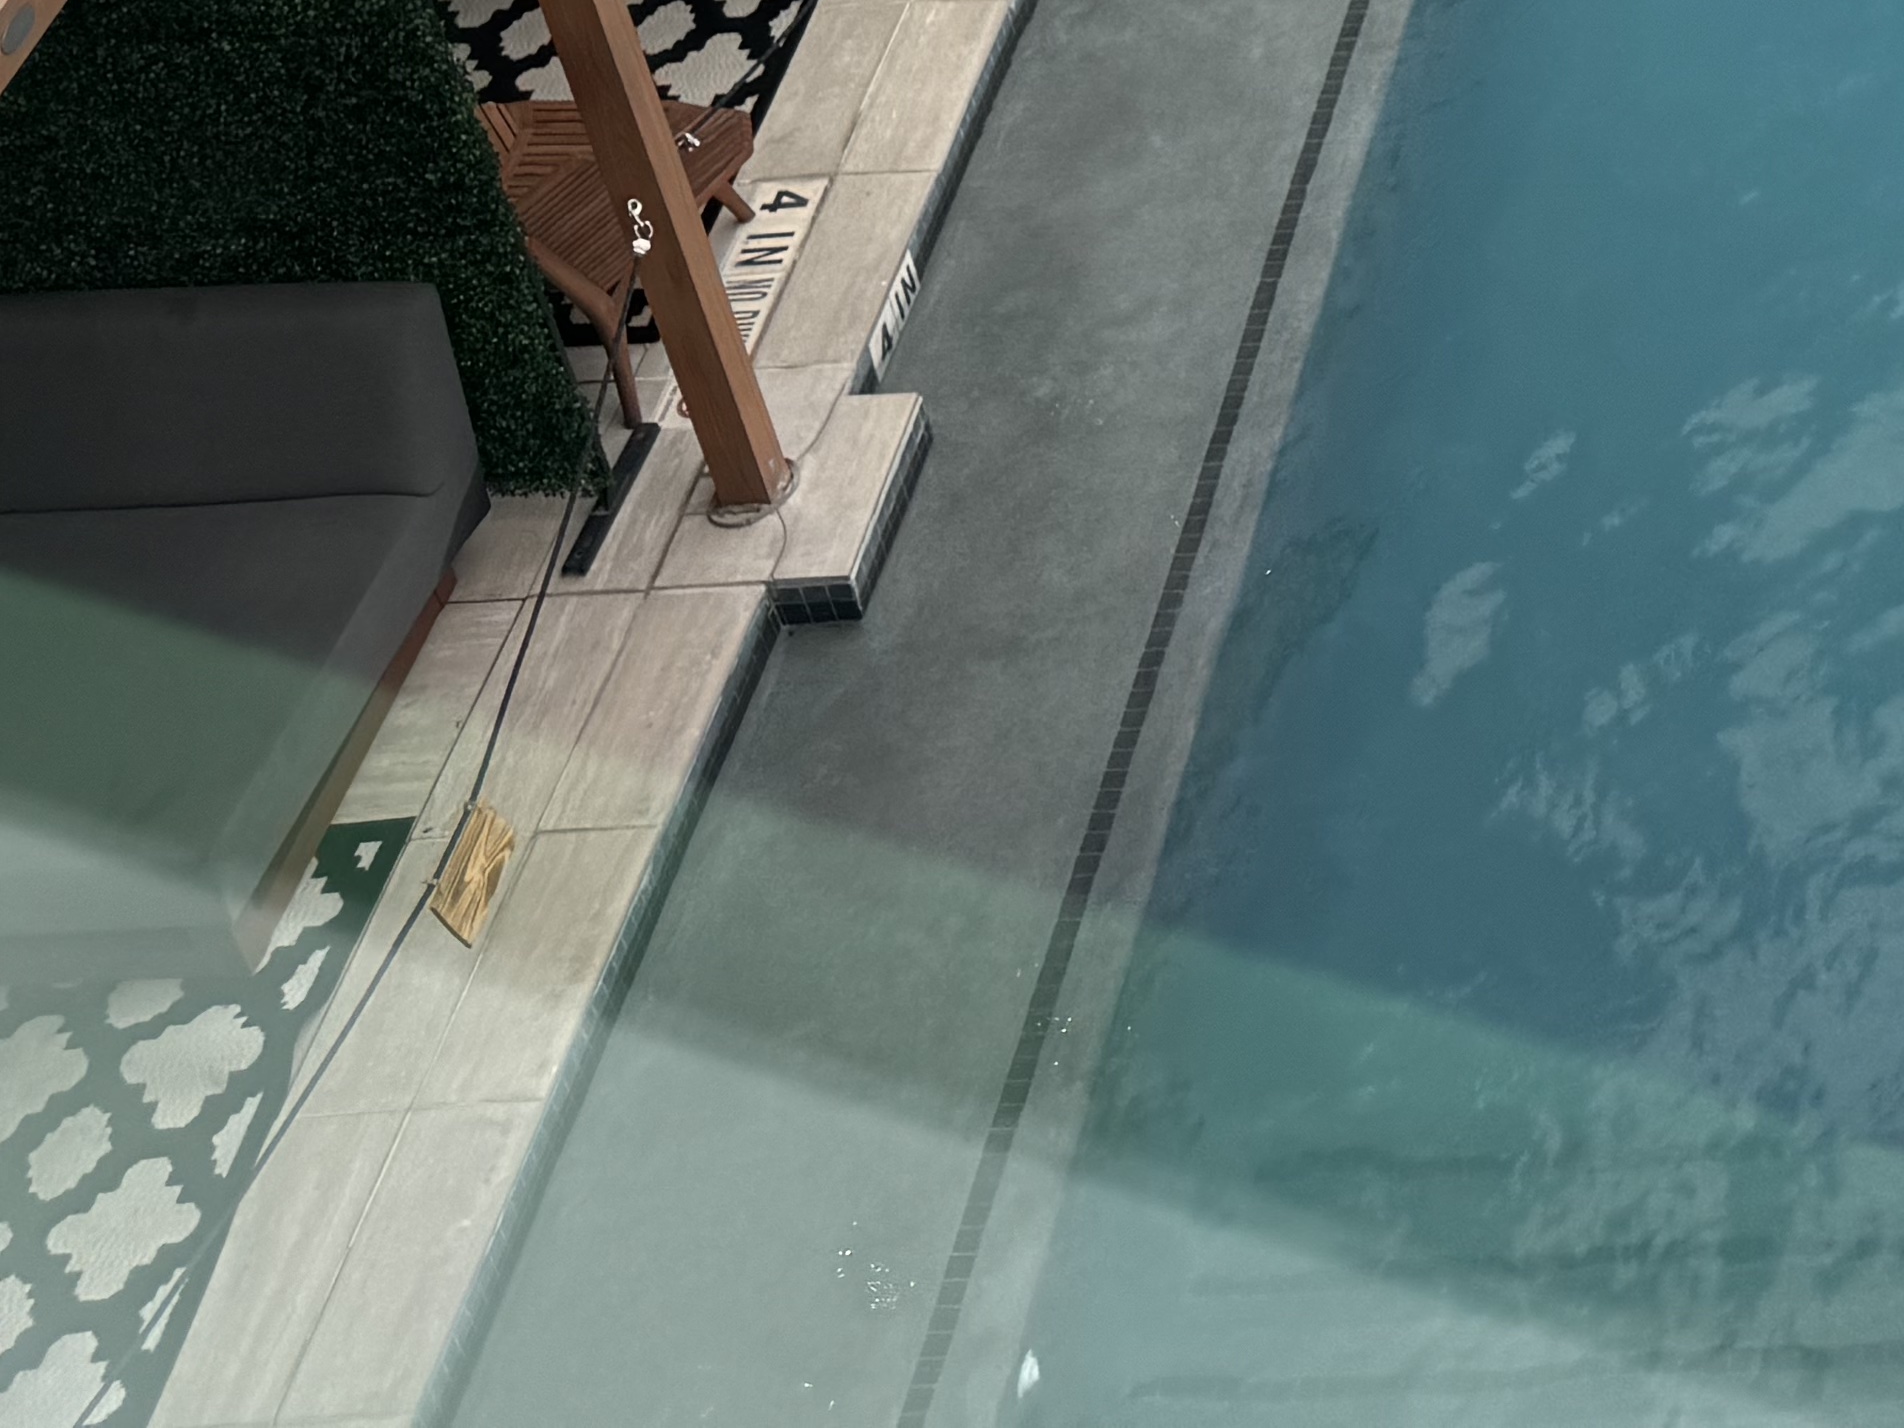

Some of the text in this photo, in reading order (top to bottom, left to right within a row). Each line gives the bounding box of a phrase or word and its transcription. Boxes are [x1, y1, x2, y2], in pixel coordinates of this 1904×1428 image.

[759, 189, 809, 213] 4
[734, 231, 796, 268] IN
[725, 277, 775, 302] NO
[881, 264, 917, 362] 4 IN
